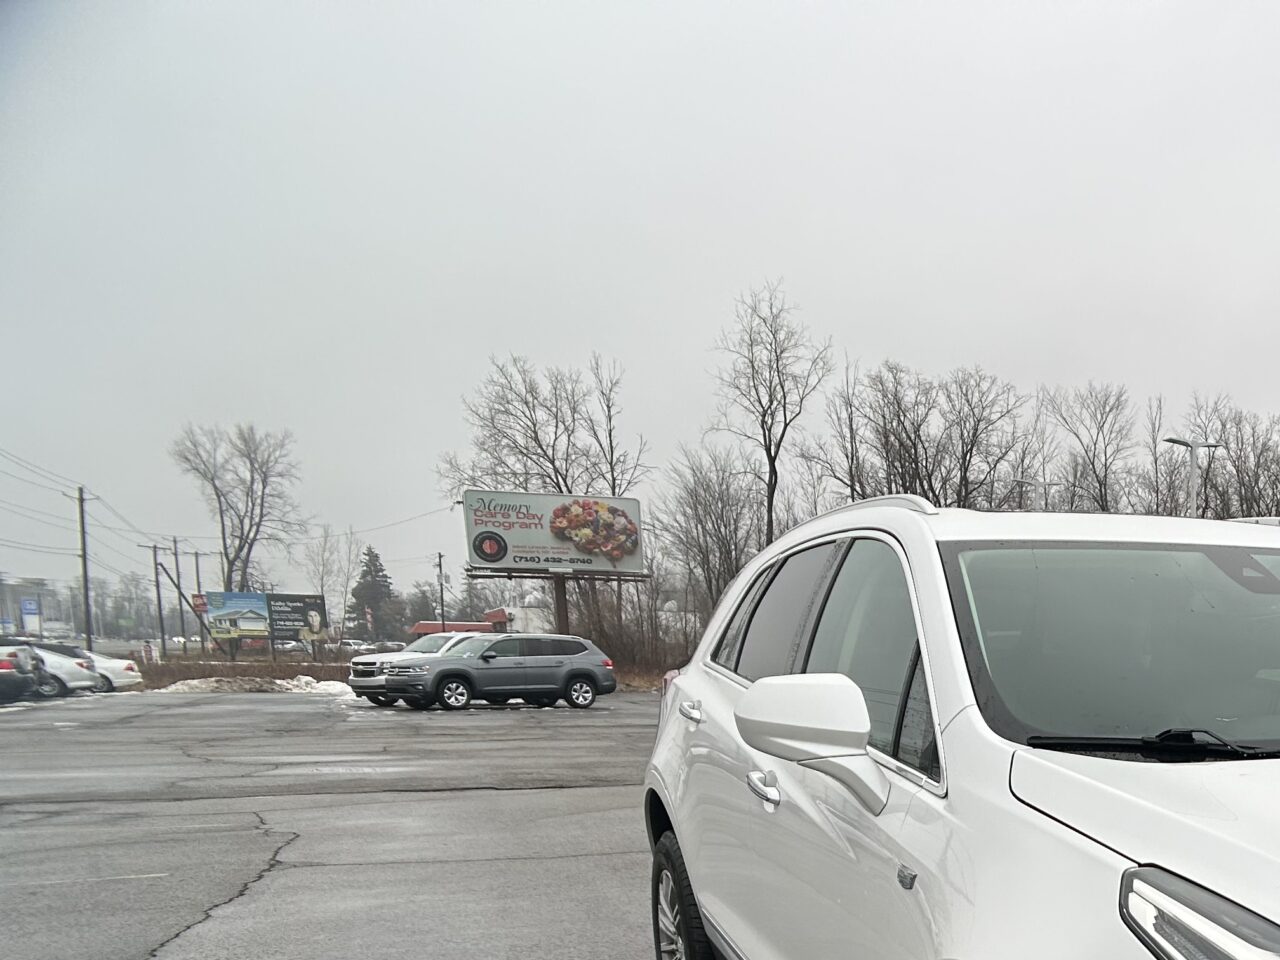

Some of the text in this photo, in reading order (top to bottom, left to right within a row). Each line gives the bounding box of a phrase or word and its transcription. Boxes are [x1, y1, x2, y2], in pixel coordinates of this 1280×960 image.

[469, 497, 531, 513] Memory
[474, 509, 544, 522] Care Day
[474, 518, 544, 531] Program
[513, 555, 541, 564] (716)
